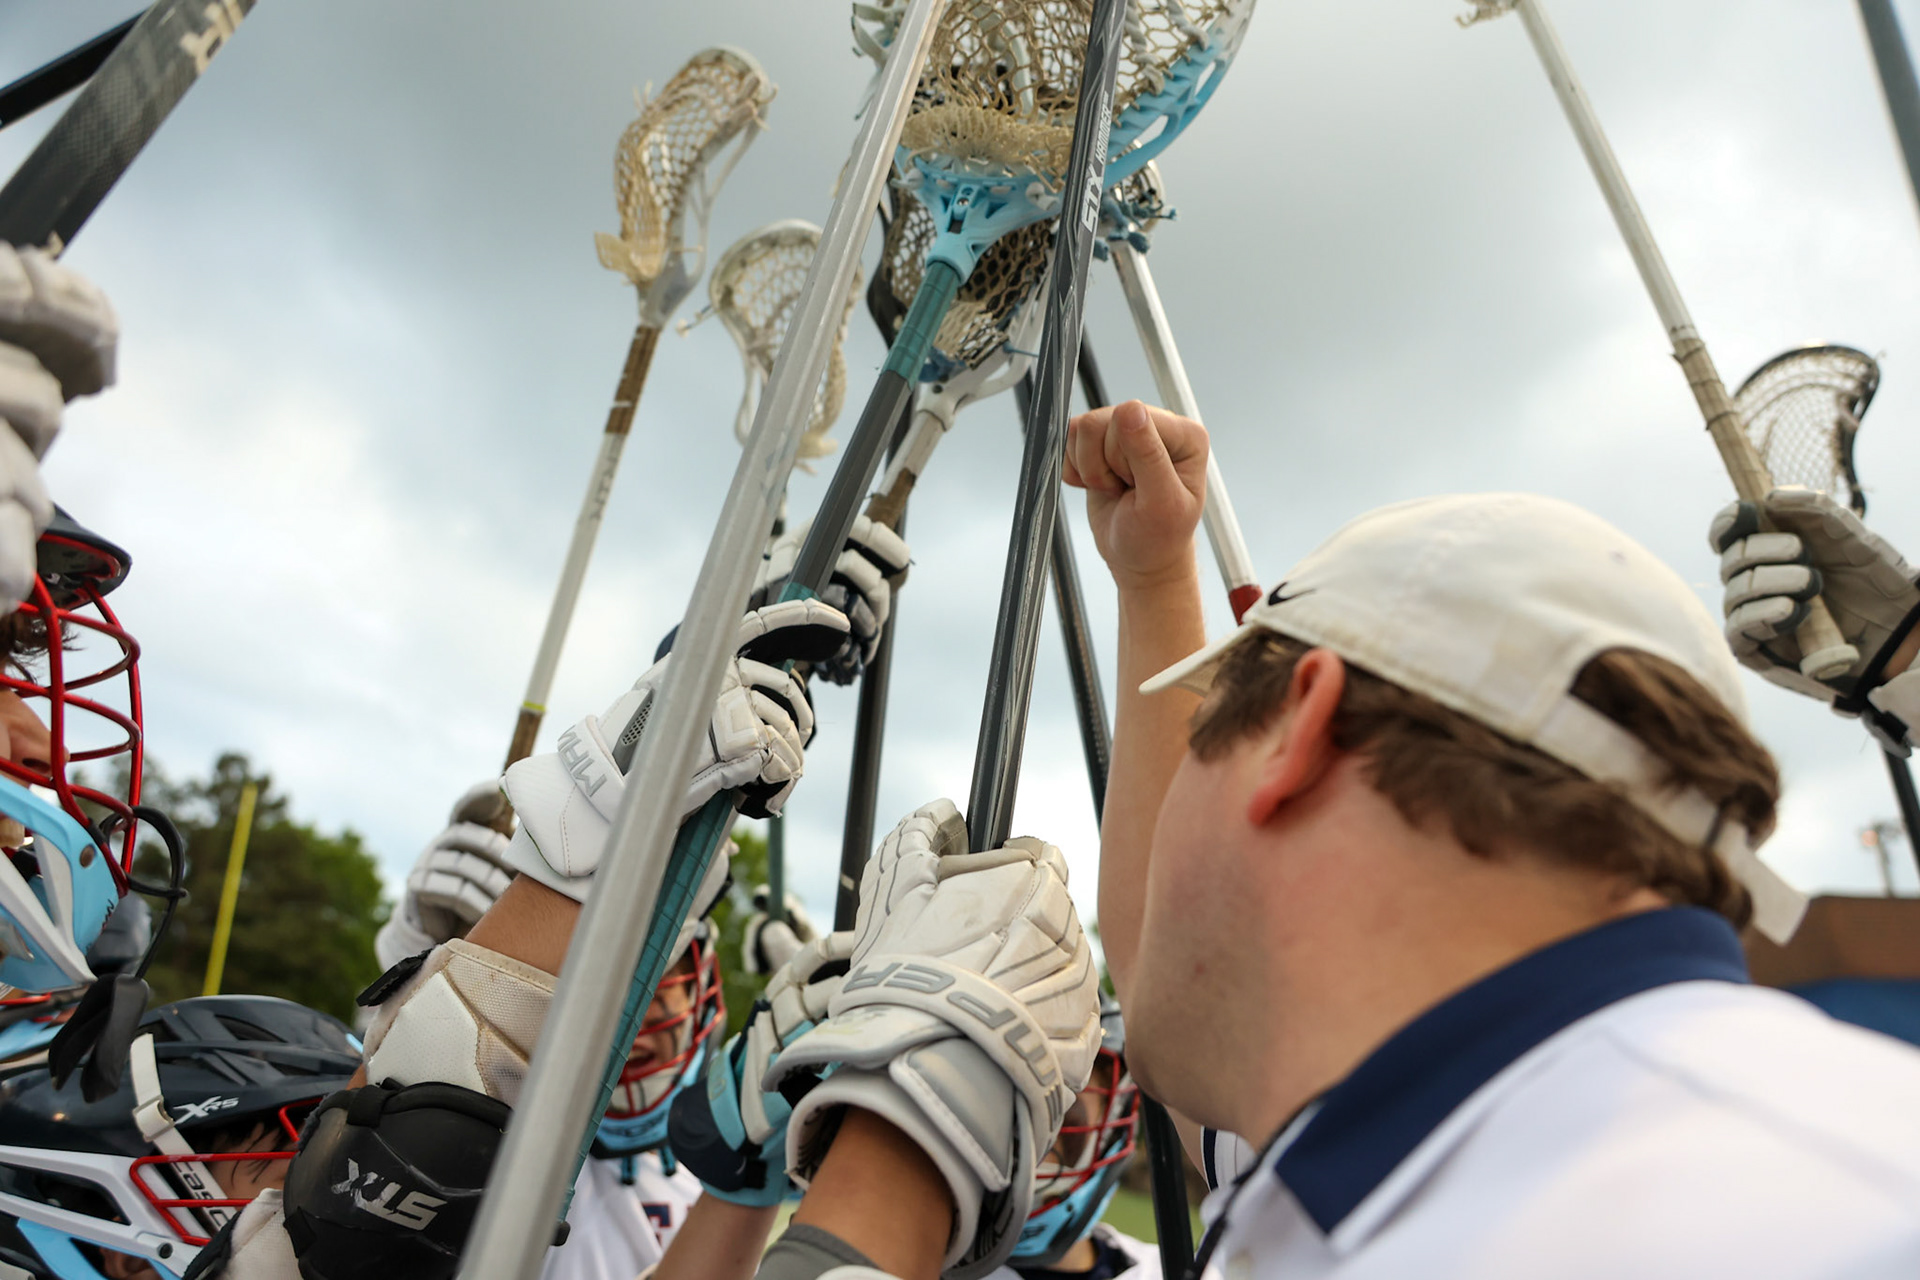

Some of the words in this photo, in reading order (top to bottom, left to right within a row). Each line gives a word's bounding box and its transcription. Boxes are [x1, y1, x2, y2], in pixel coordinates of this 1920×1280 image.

[1080, 163, 1102, 233] STX
[1095, 105, 1112, 165] HAMMER
[557, 724, 608, 797] MAV
[172, 1095, 240, 1125] XRS
[330, 1157, 449, 1231] STX
